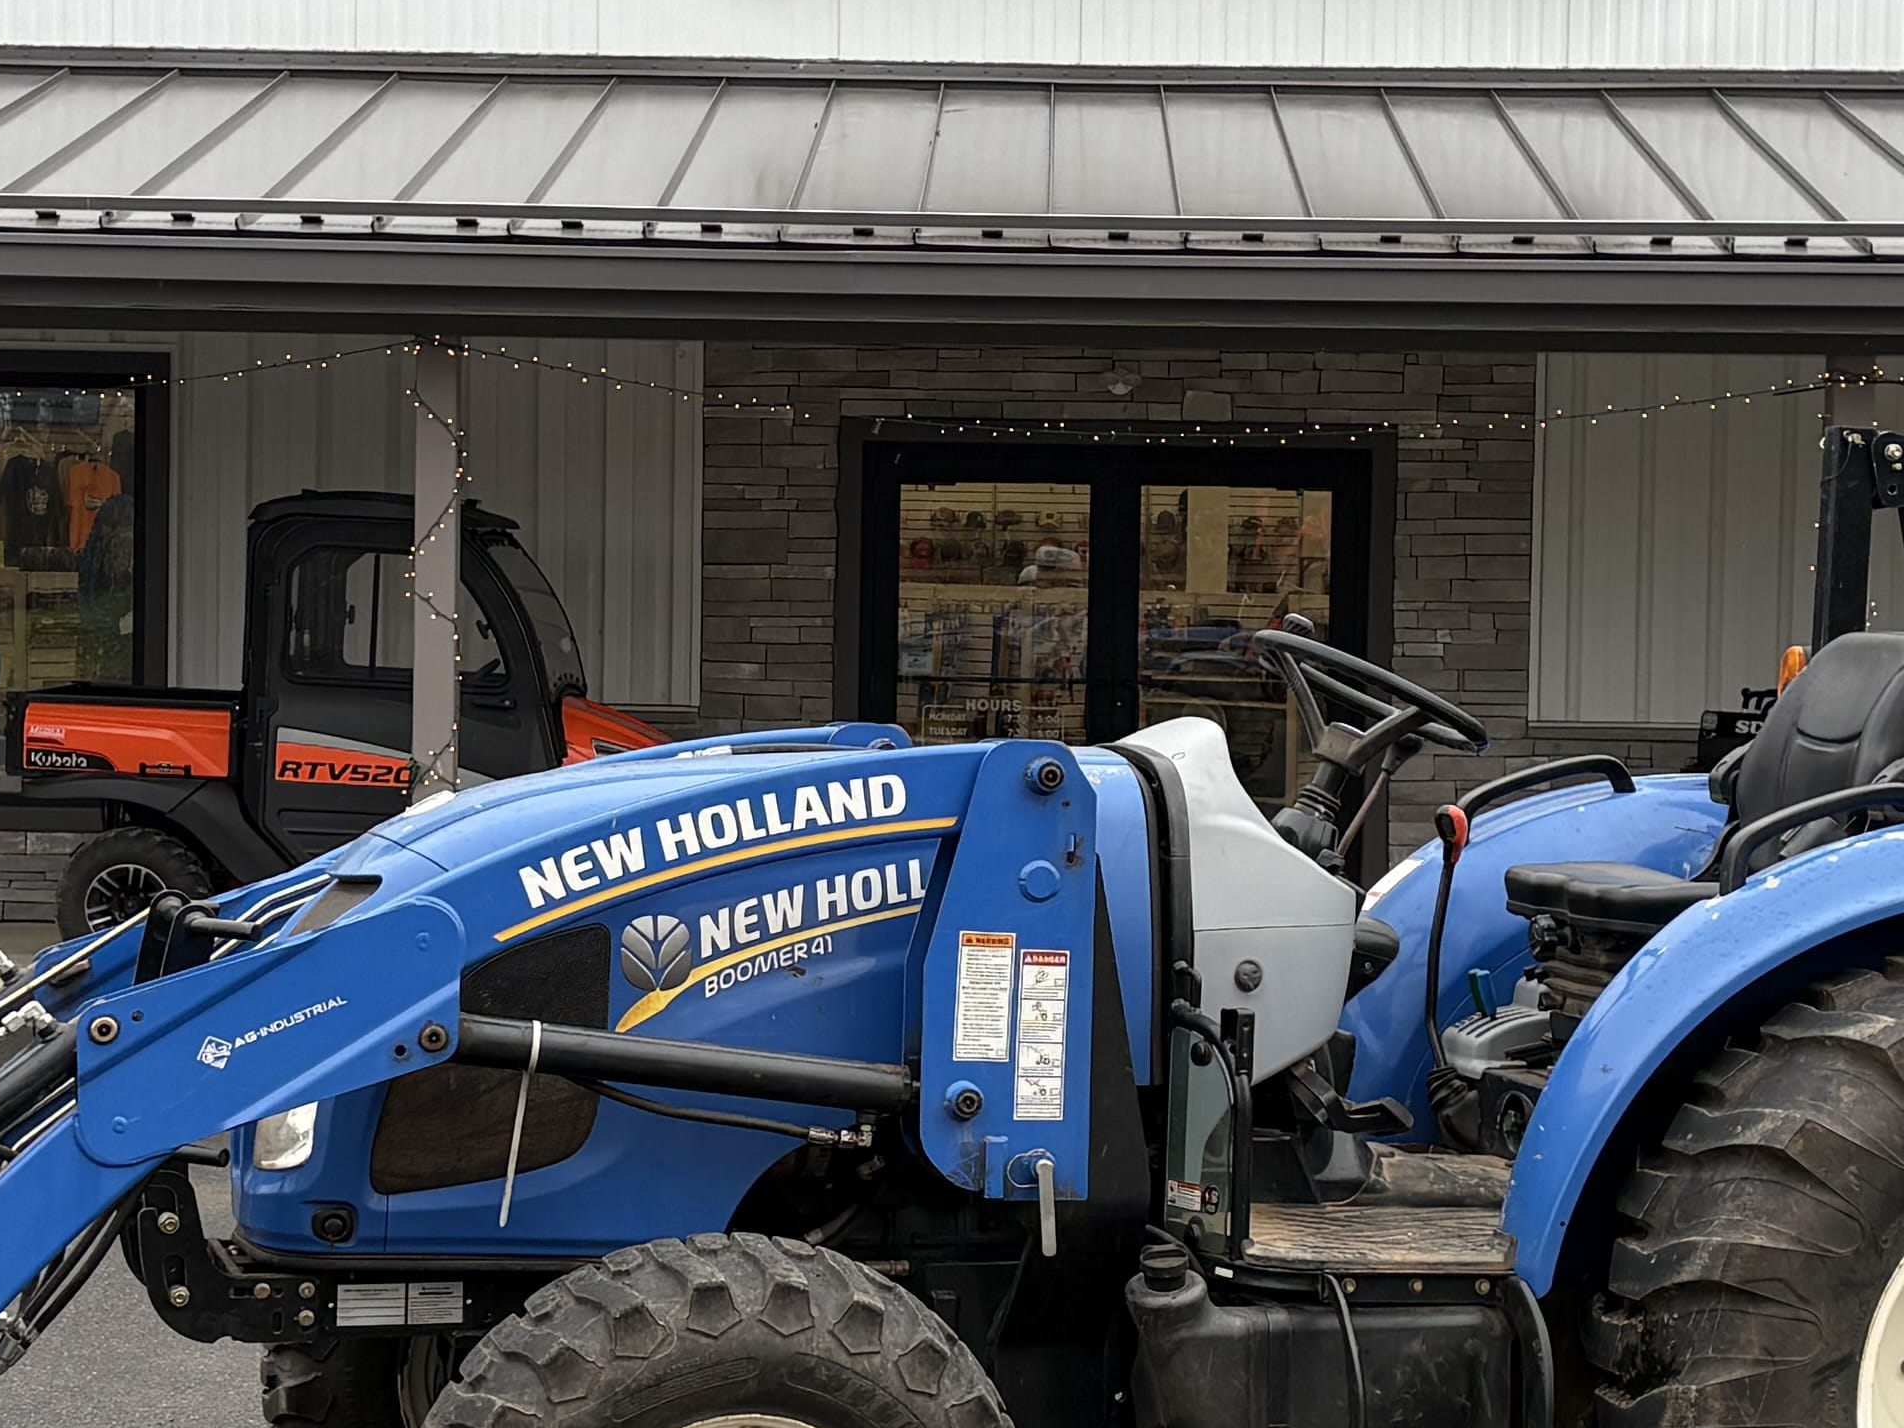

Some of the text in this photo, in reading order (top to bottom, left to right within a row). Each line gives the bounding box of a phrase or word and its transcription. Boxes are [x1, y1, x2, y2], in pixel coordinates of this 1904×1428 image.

[965, 698, 1023, 712] HOURS
[31, 752, 88, 768] Kubota
[277, 761, 414, 785] RTV520
[518, 773, 908, 909] NEW HOLLAND
[699, 858, 926, 959] NEW HOLL
[704, 934, 833, 999] BOOMER 41
